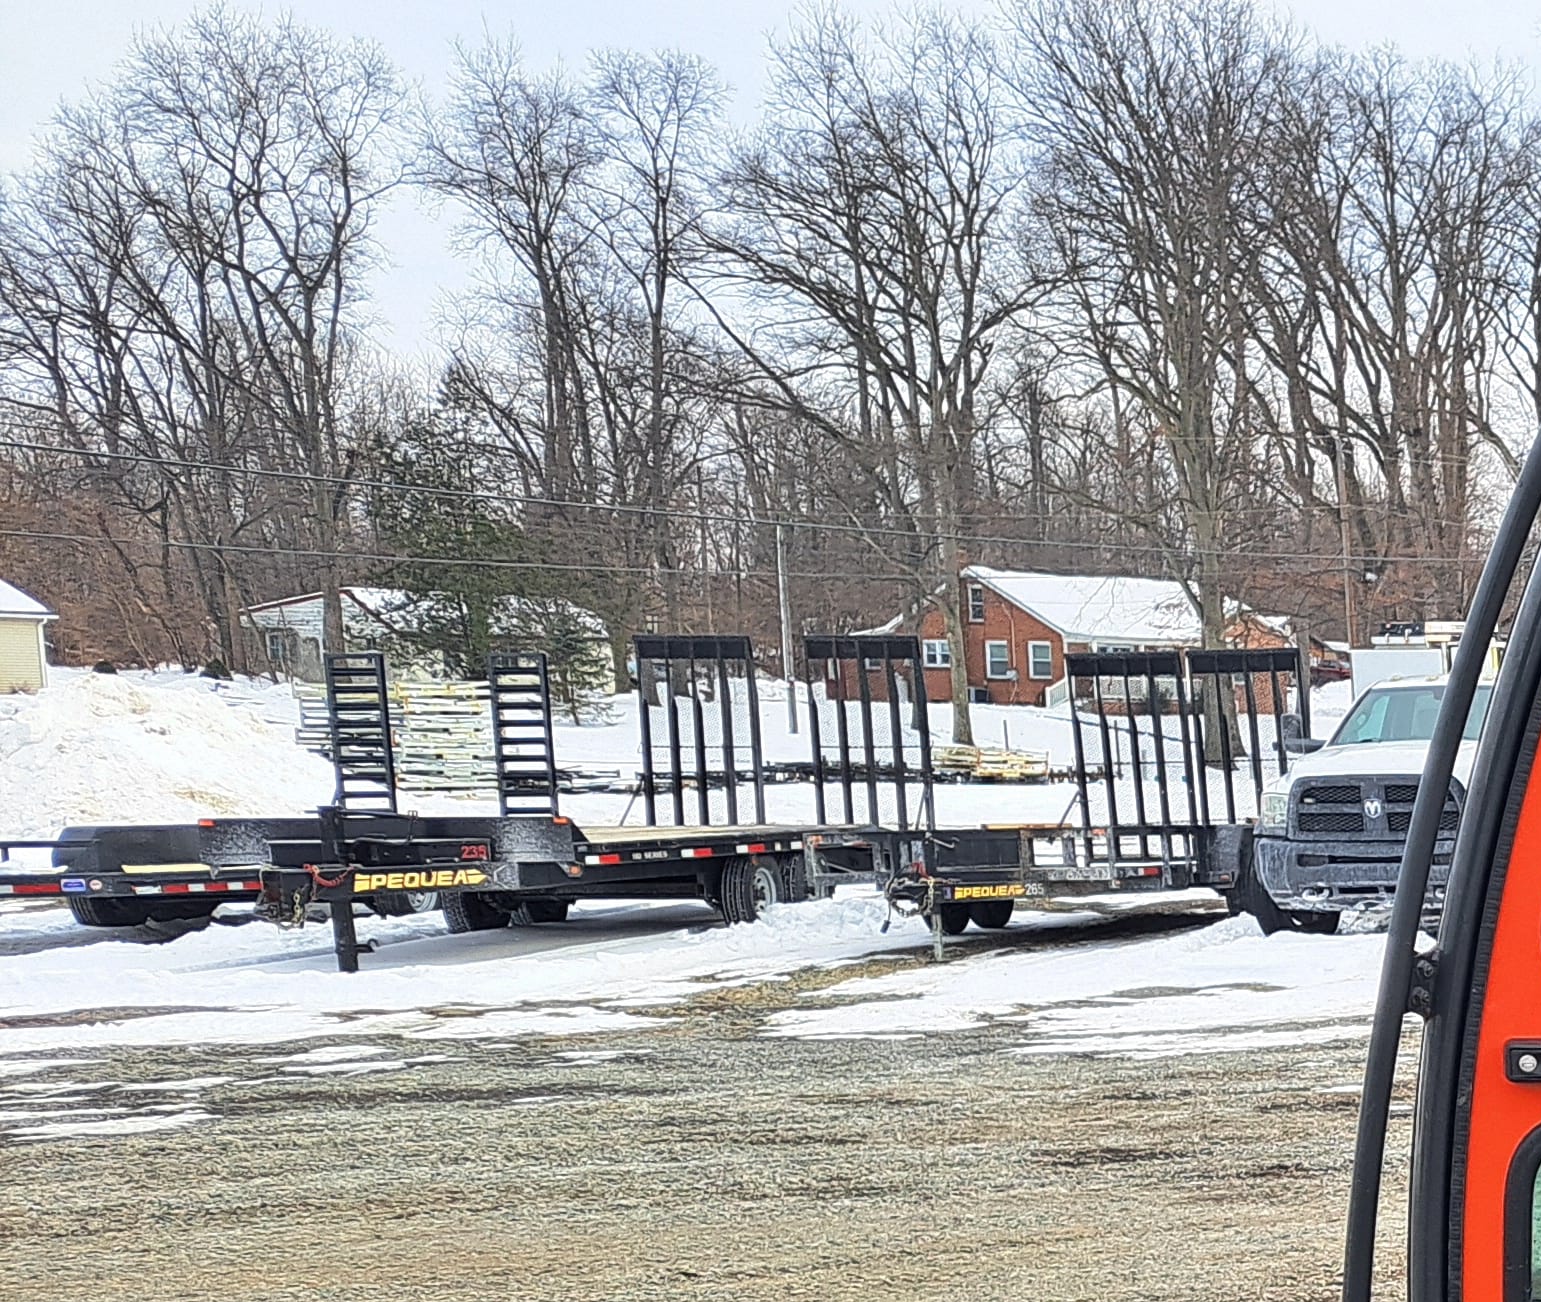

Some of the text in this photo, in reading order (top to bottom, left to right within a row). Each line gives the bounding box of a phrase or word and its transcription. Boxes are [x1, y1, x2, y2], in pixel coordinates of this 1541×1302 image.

[371, 870, 467, 890] PEQUEA
[963, 885, 1015, 898] PEQUEA
[1025, 883, 1044, 895] 265
